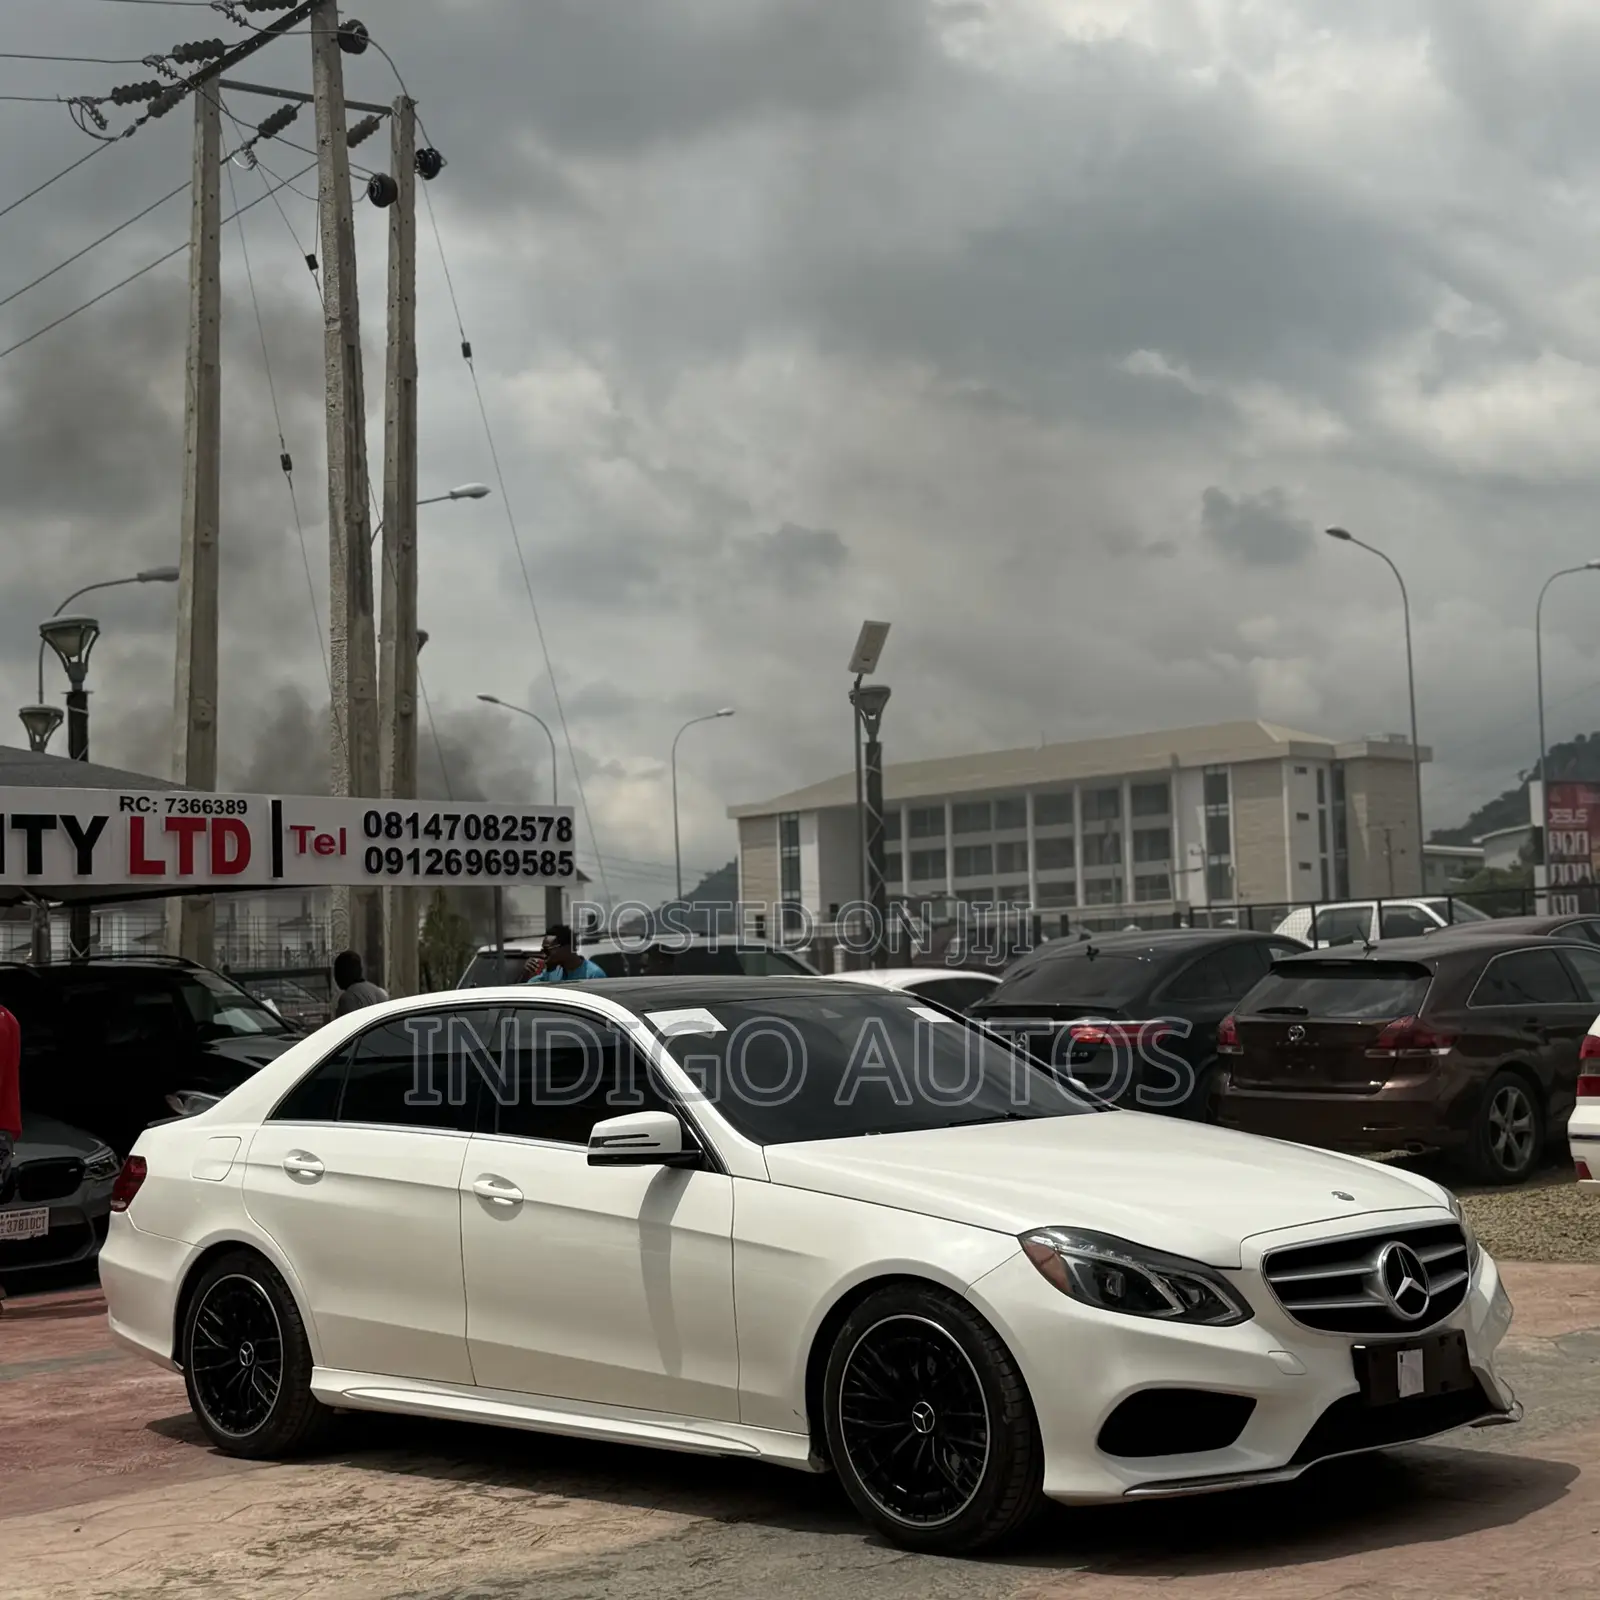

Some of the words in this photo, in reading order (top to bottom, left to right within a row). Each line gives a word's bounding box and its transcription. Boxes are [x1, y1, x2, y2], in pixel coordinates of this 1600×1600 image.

[119, 796, 158, 813] RC:
[164, 798, 248, 814] 7366389
[290, 825, 347, 855] Tel
[363, 810, 573, 842] 08147082578
[129, 816, 251, 875] LTD
[365, 846, 574, 876] 09126969585
